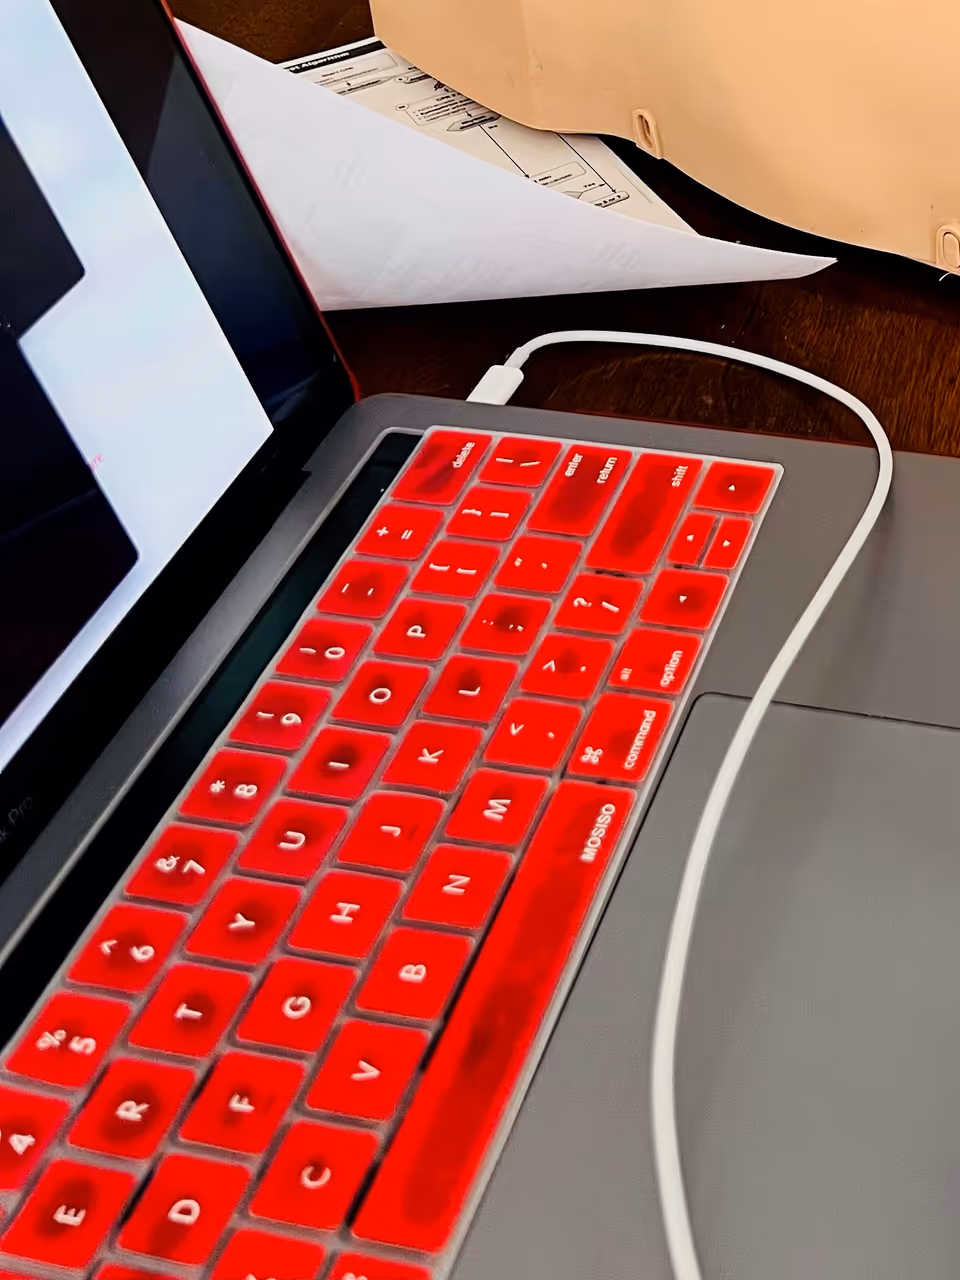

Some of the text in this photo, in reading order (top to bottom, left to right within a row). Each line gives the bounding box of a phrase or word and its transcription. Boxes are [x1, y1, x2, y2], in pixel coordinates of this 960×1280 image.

[452, 442, 476, 468] delete
[564, 453, 584, 477] enter
[596, 457, 618, 484] return
[671, 465, 689, 487] shift
[406, 625, 426, 638] P
[660, 650, 683, 687] option
[369, 687, 392, 704] O
[458, 686, 481, 696] L
[280, 712, 302, 726] 9
[624, 709, 657, 770] command
[418, 748, 444, 763] K
[234, 784, 258, 799] 8
[483, 799, 512, 821] M
[278, 830, 306, 850] U
[380, 825, 402, 837] J
[580, 803, 616, 862] MOSISO
[182, 859, 206, 874] 7
[442, 874, 471, 894] N
[229, 913, 256, 929] Y
[330, 902, 361, 923] H
[130, 945, 155, 961] 6
[399, 964, 427, 982] B
[175, 1003, 203, 1019] T
[283, 996, 311, 1019] G
[69, 1036, 96, 1054] 5
[352, 1060, 380, 1079] V
[116, 1100, 149, 1121] R
[229, 1094, 254, 1113] F
[9, 1133, 36, 1155] 4
[302, 1167, 331, 1188] C
[53, 1205, 86, 1226] E
[168, 1199, 200, 1224] D
